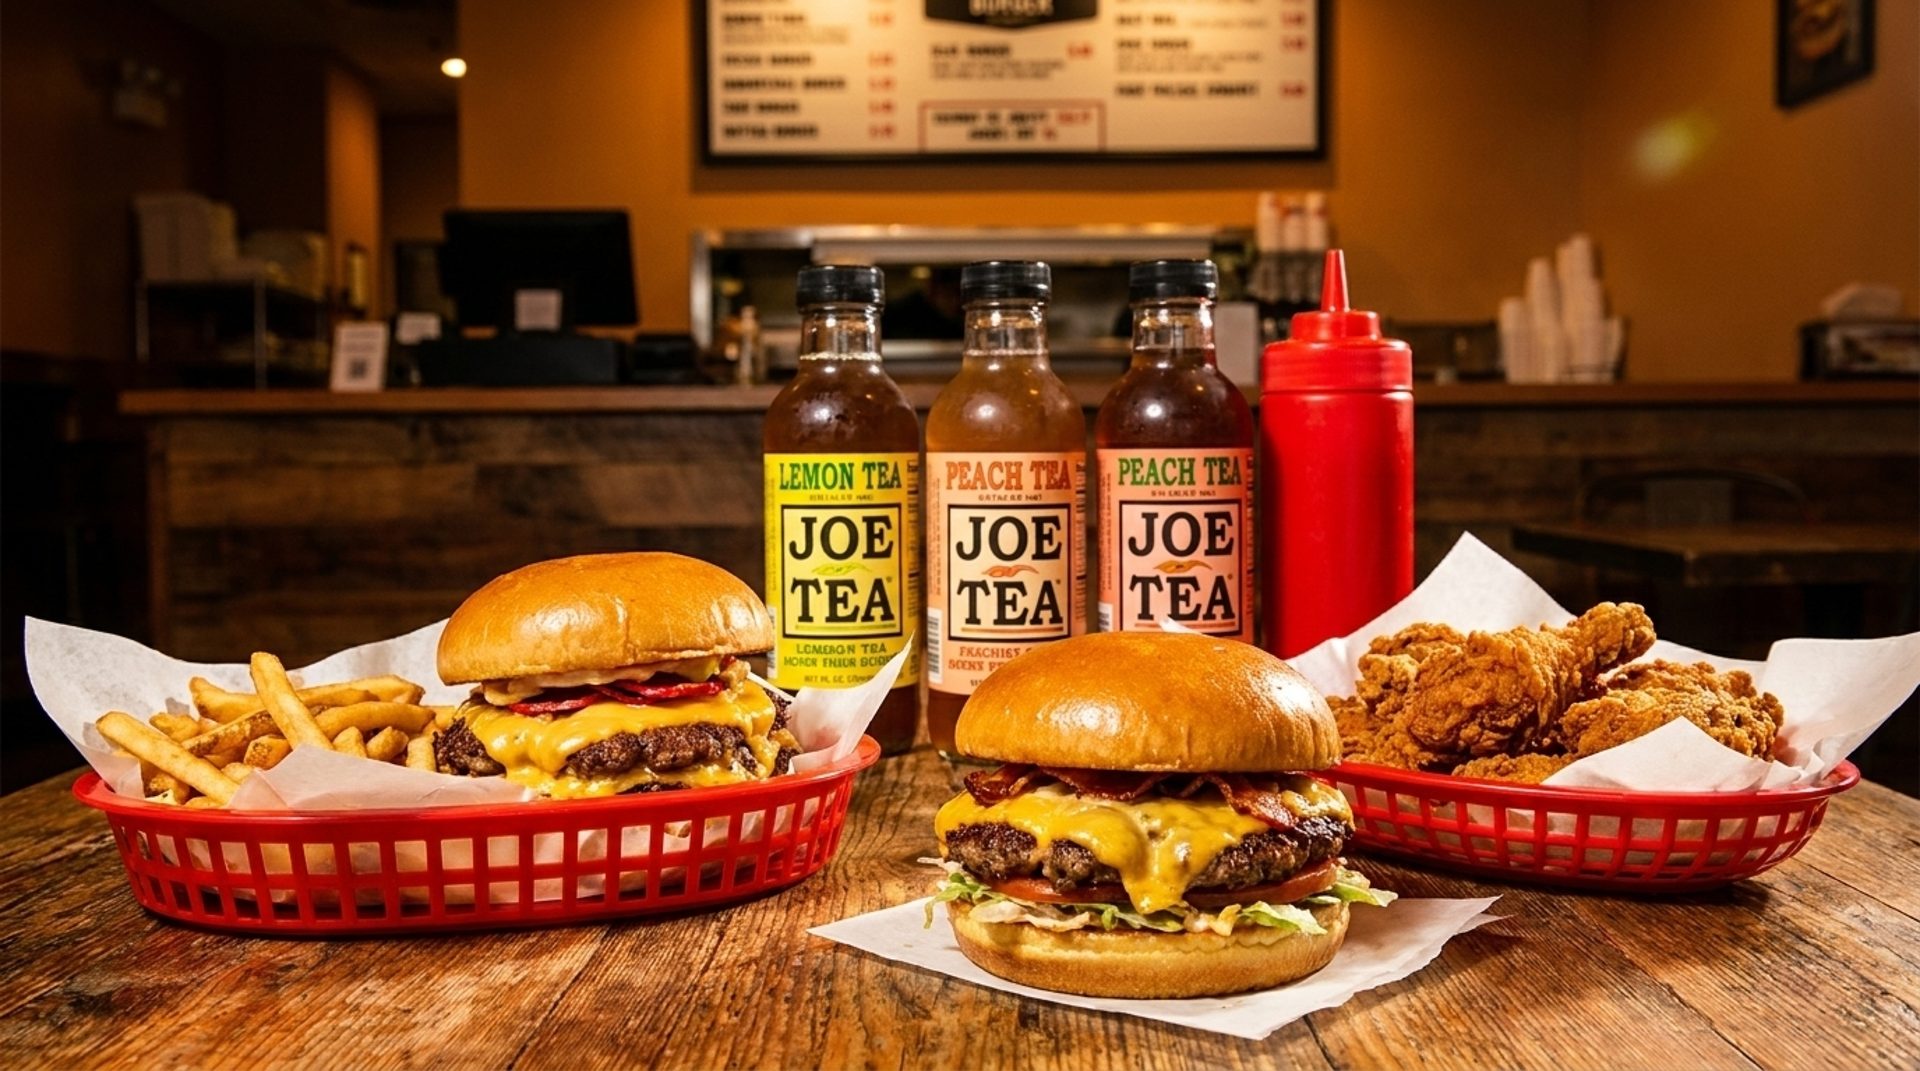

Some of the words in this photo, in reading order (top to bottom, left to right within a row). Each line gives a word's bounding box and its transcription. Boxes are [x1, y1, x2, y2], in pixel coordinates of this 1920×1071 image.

[779, 462, 854, 490] LEMON
[862, 461, 902, 489] TEA
[946, 461, 1023, 490] PEACH
[1030, 460, 1071, 490] TEA
[1118, 457, 1196, 486] PEACH
[1203, 456, 1241, 486] TEA
[789, 515, 894, 561] JOE
[955, 515, 1062, 561] JOE
[1128, 511, 1235, 557] JOE
[790, 577, 895, 623] TEA
[957, 579, 1063, 626] TEA
[1129, 574, 1236, 621] TEA
